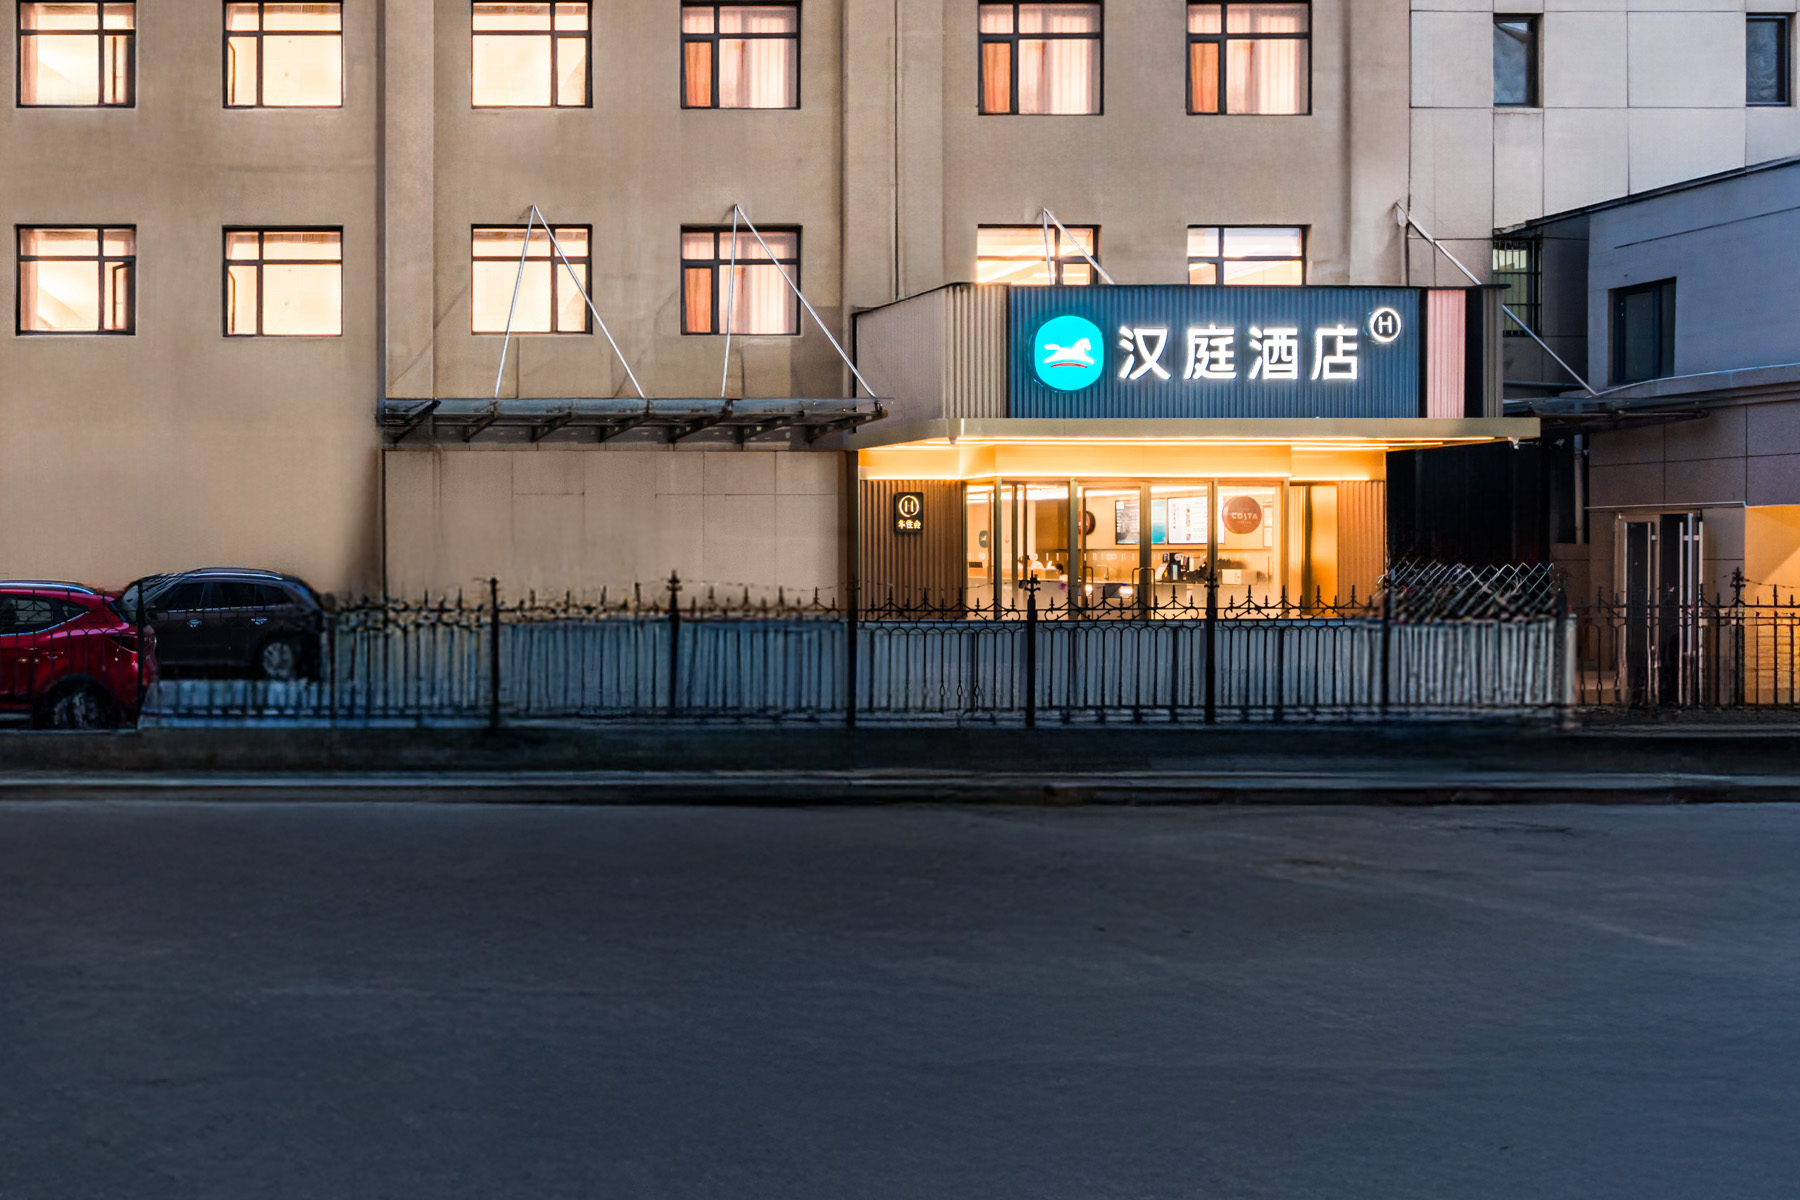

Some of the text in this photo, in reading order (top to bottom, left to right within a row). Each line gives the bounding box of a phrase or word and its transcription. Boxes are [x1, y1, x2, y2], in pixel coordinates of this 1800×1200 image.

[1119, 325, 1358, 380] 汉庭酒店
[1231, 512, 1258, 520] COSTA
